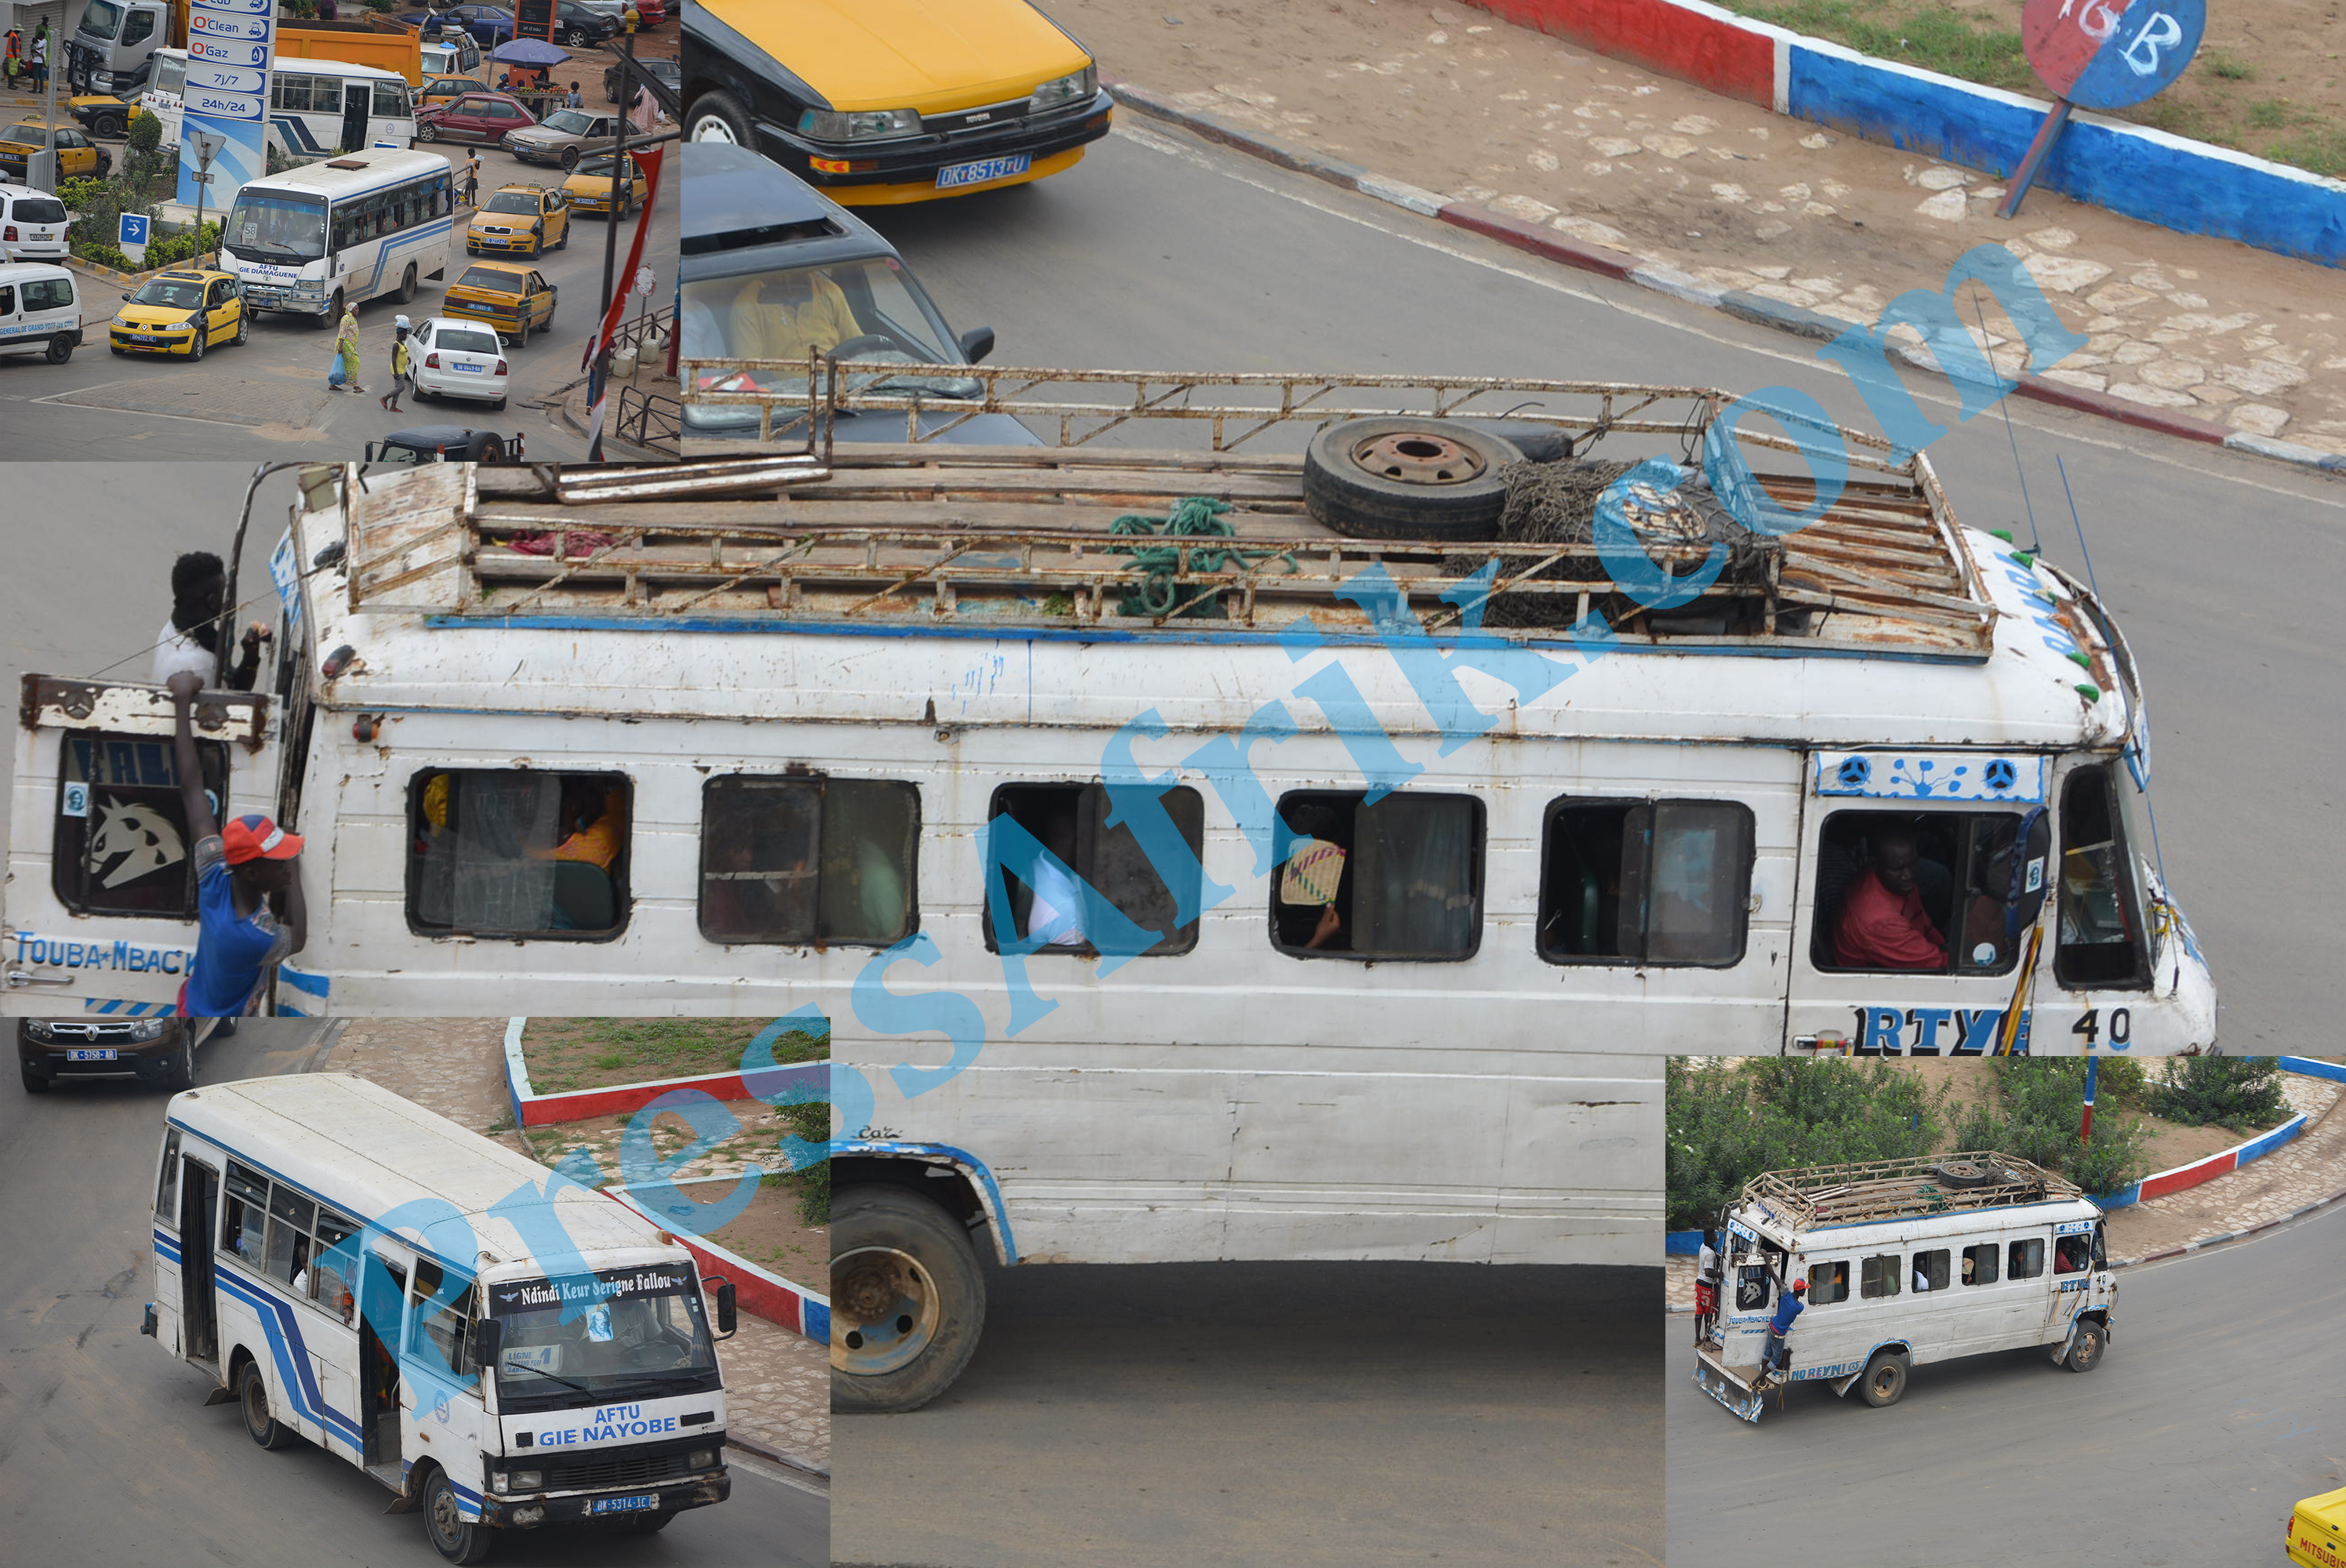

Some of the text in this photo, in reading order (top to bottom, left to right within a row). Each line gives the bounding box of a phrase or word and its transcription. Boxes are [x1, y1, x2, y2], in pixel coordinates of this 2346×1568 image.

[194, 16, 239, 33] O'Clean
[191, 42, 229, 59] O'Gaz
[214, 73, 239, 85] 7j/7
[202, 98, 246, 112] 24h/24
[245, 226, 256, 234] 58
[251, 267, 298, 279] DIAMAGUENE
[521, 1285, 561, 1305] Ndindi
[562, 1283, 590, 1300] Keur
[636, 1272, 672, 1290] Fallou
[508, 1348, 551, 1364] LIGNE 1
[595, 1404, 640, 1424] AFTU
[539, 1428, 577, 1446] GIE
[583, 1417, 677, 1442] NAYOBE
